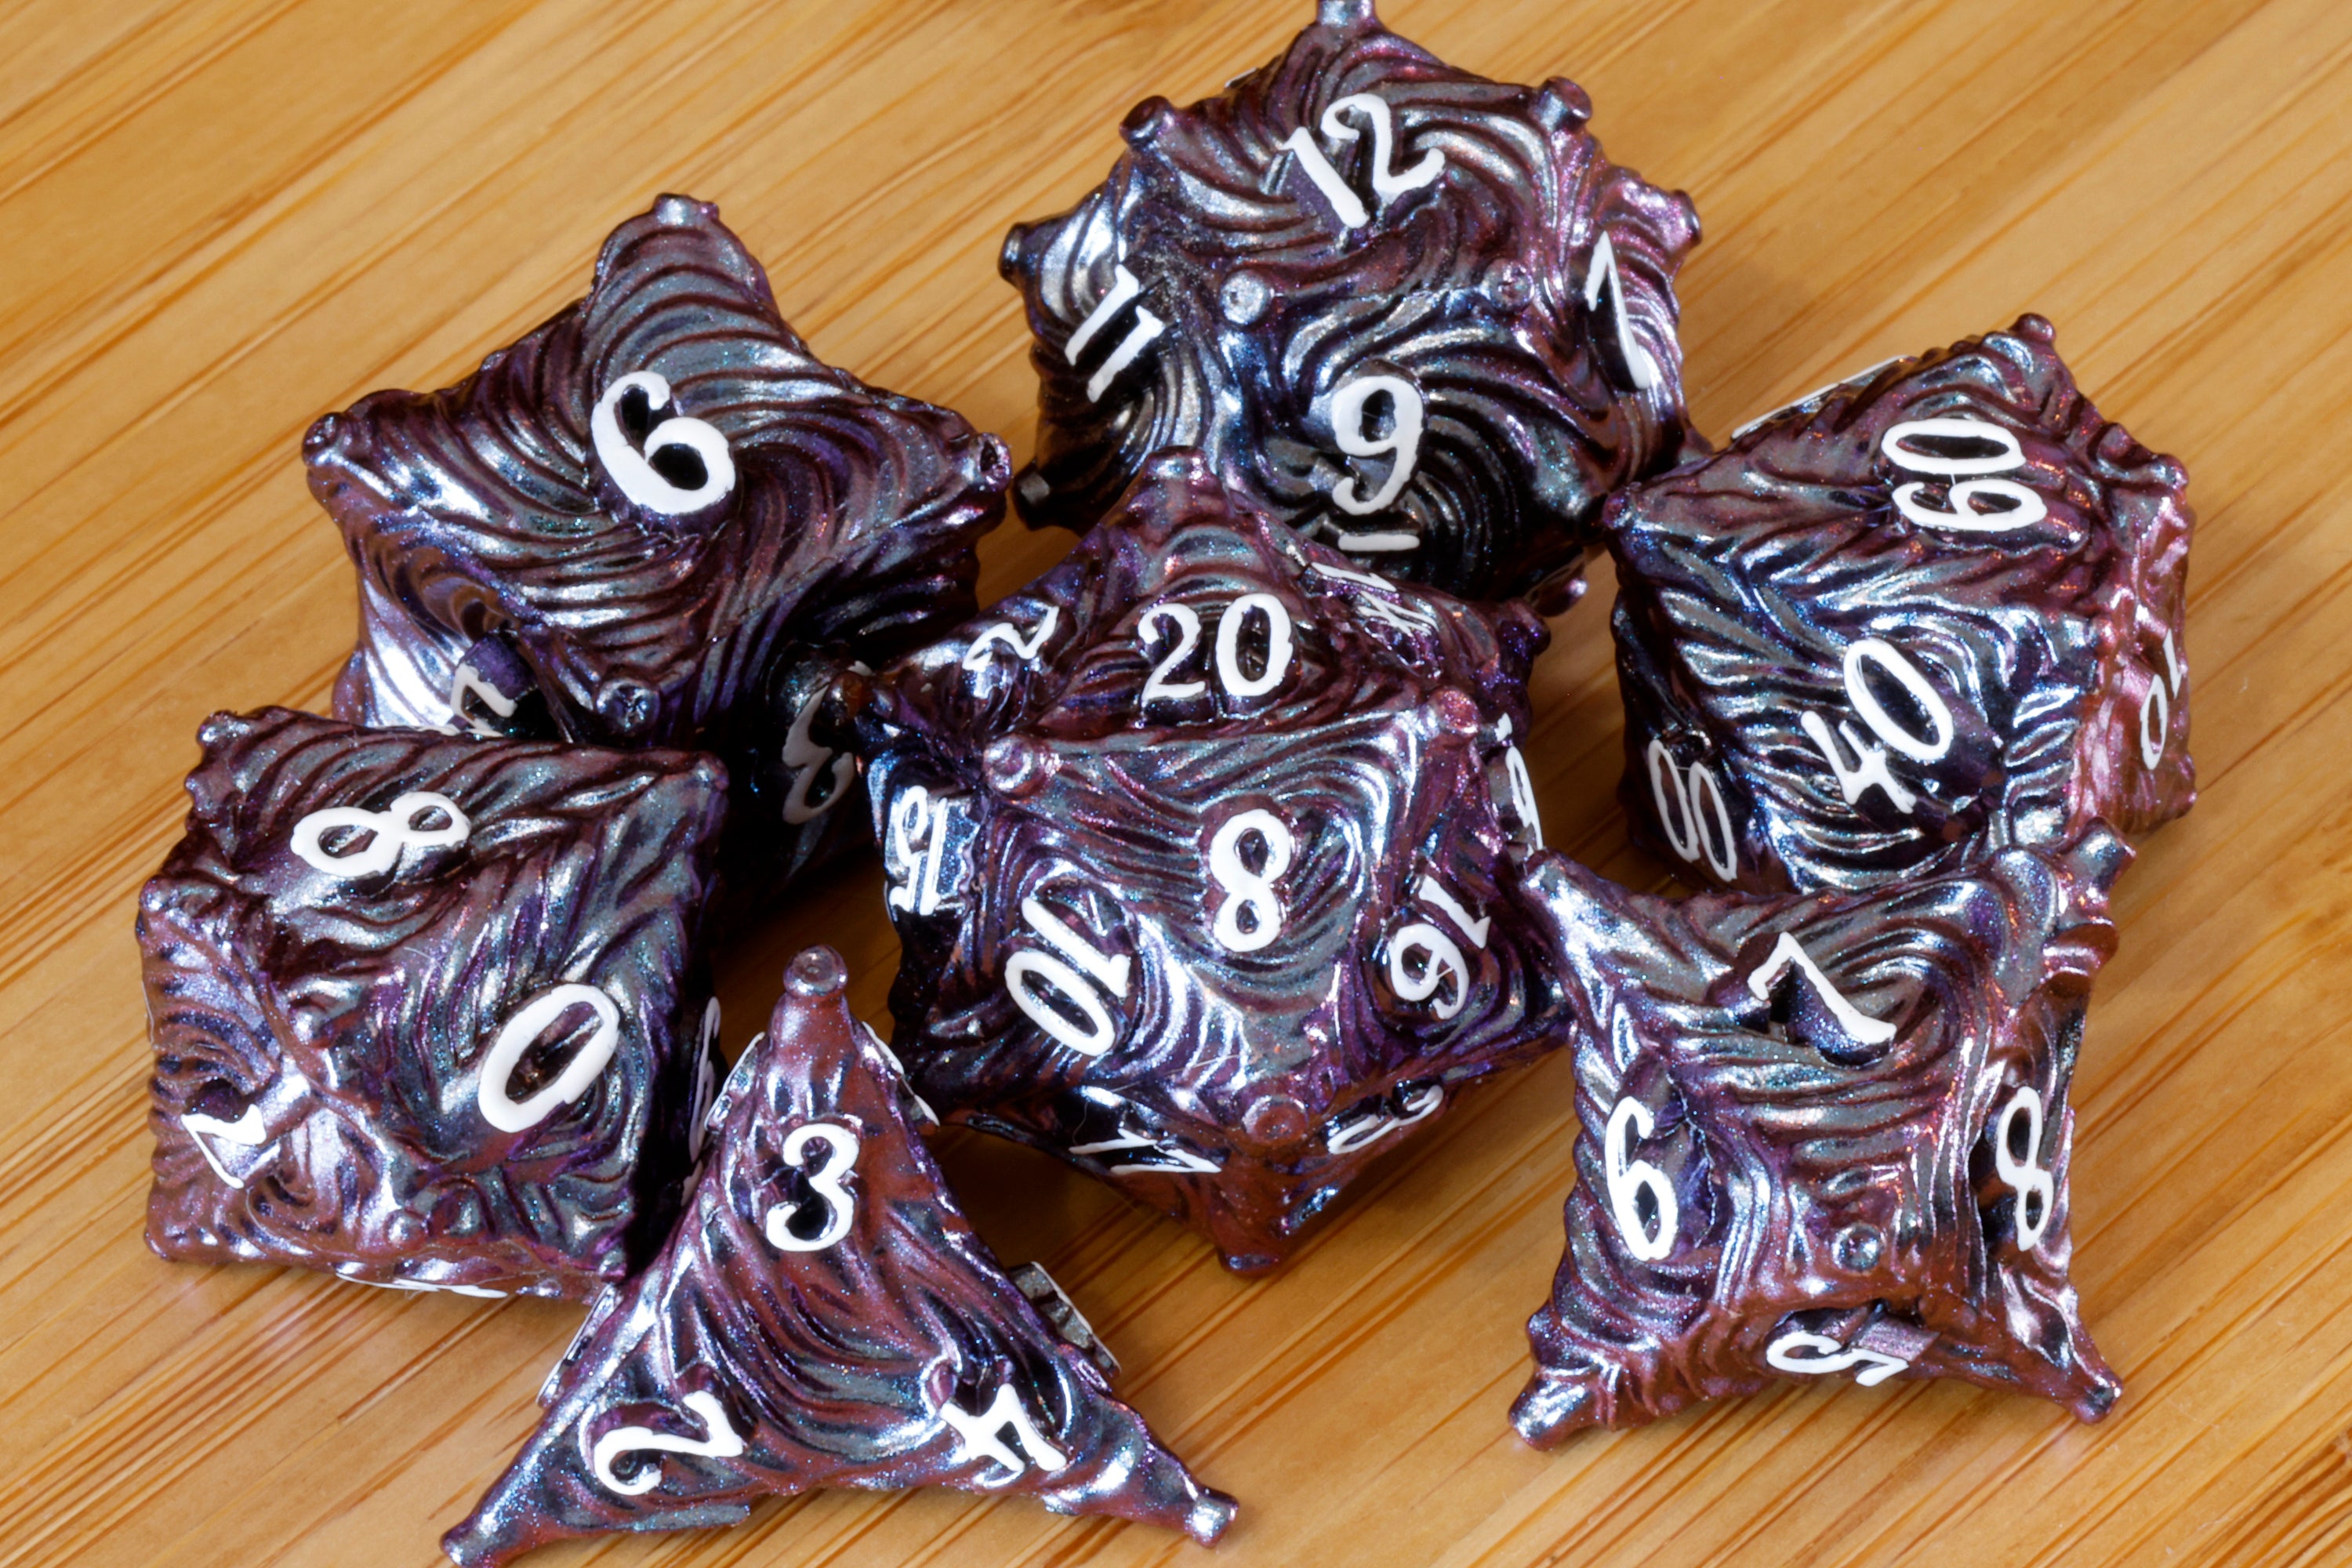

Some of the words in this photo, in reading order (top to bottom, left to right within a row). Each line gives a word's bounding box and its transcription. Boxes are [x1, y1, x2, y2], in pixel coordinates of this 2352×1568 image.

[1282, 93, 1446, 228] 12
[1065, 264, 1163, 402] 11
[590, 371, 736, 514] 6
[1331, 376, 1424, 514] 9
[1882, 418, 2048, 532] 60
[1138, 593, 1294, 698] 20
[1801, 639, 1955, 815] 40
[290, 791, 470, 877] 8
[1648, 740, 1737, 881] 00
[1209, 808, 1296, 953] 8
[1004, 895, 1131, 1056] 10
[1748, 931, 1898, 1044] 7
[478, 983, 621, 1133] 0
[767, 1123, 859, 1252] 3
[1605, 1095, 1679, 1261] 6
[1995, 1085, 2054, 1250] 8
[593, 1391, 743, 1496] 2
[940, 1383, 1067, 1472] 4
